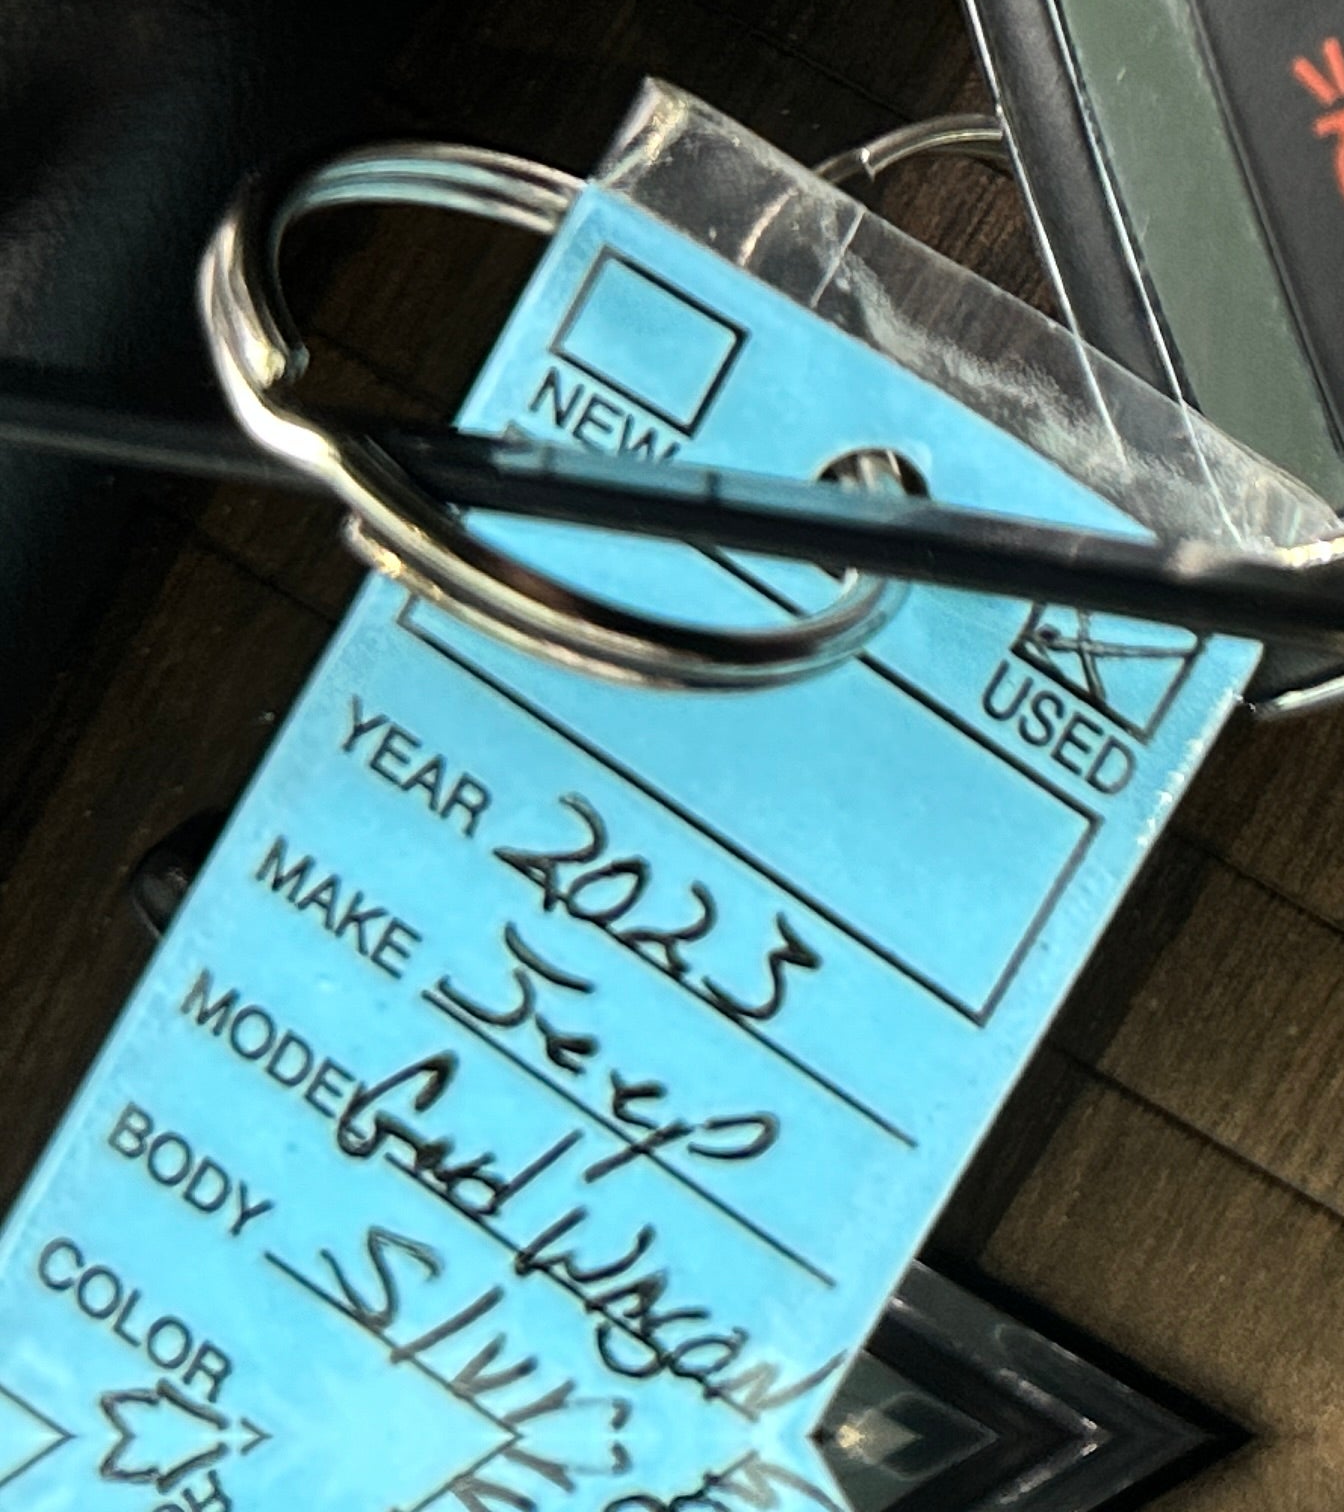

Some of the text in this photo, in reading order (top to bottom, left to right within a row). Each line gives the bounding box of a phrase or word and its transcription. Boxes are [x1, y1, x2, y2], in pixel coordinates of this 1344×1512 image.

[343, 696, 492, 838] YEAR
[980, 660, 1136, 798] USED
[255, 835, 423, 980] MAKE
[495, 792, 824, 1023] 2023
[436, 922, 781, 1183] Jeep
[107, 1101, 275, 1237] BODY
[38, 1236, 233, 1402] COLOR
